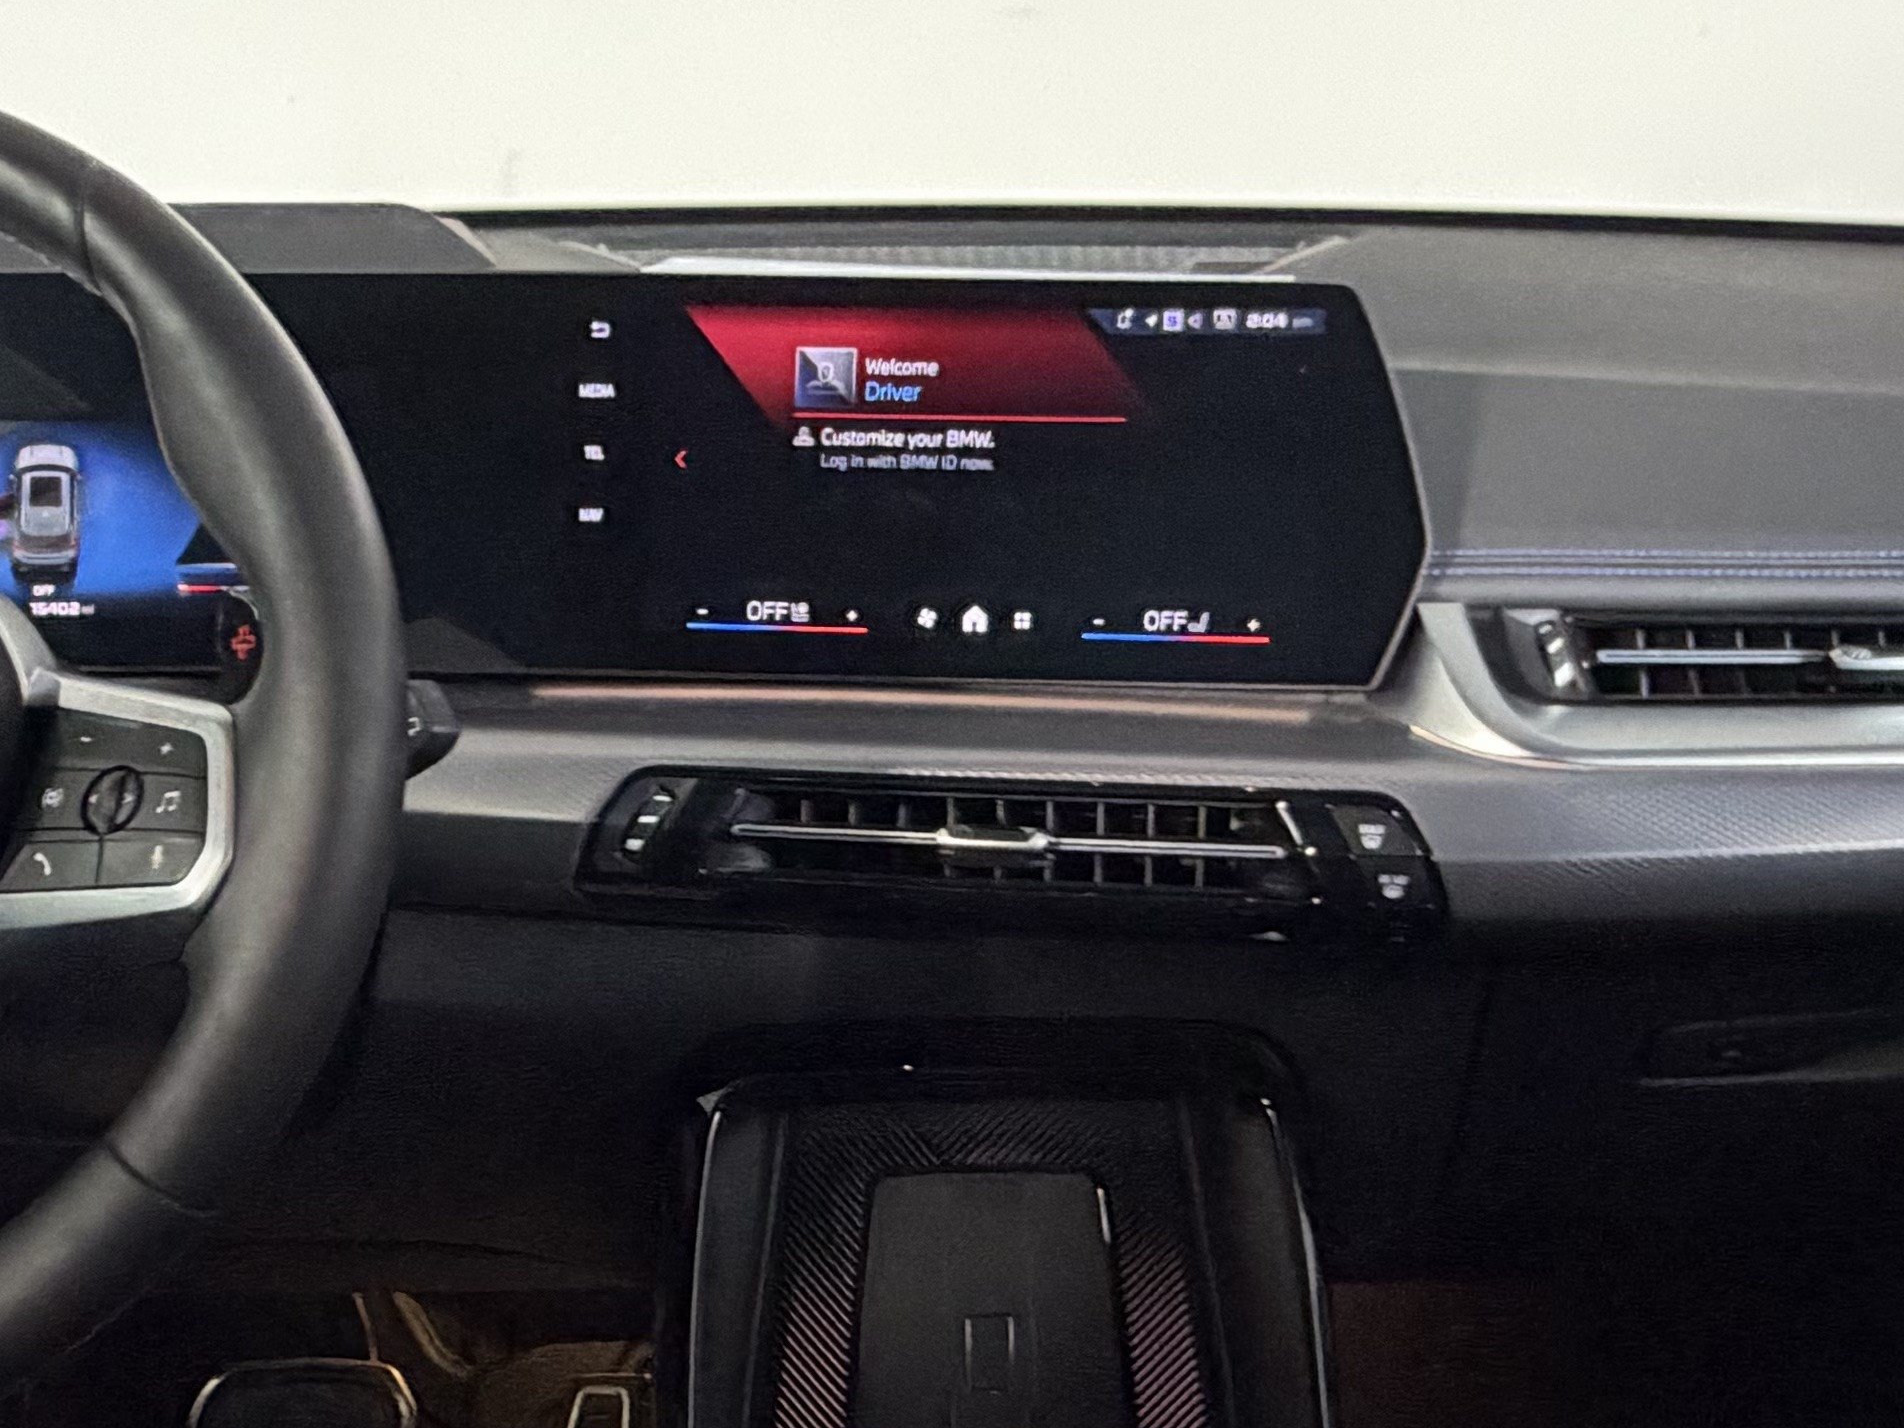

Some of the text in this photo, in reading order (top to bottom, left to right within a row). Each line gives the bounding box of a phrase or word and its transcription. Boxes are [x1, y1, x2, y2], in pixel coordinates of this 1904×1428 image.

[865, 357, 940, 377] Welcome
[578, 383, 616, 398] MEDIA
[865, 380, 922, 402] Driver
[820, 427, 996, 450] Customize your BMW.
[820, 453, 848, 471] Log
[850, 454, 865, 468] in
[867, 454, 897, 469] with
[899, 454, 939, 470] BMW
[942, 455, 957, 470] ID
[746, 600, 789, 622] OFF
[1143, 609, 1189, 632] OFF
